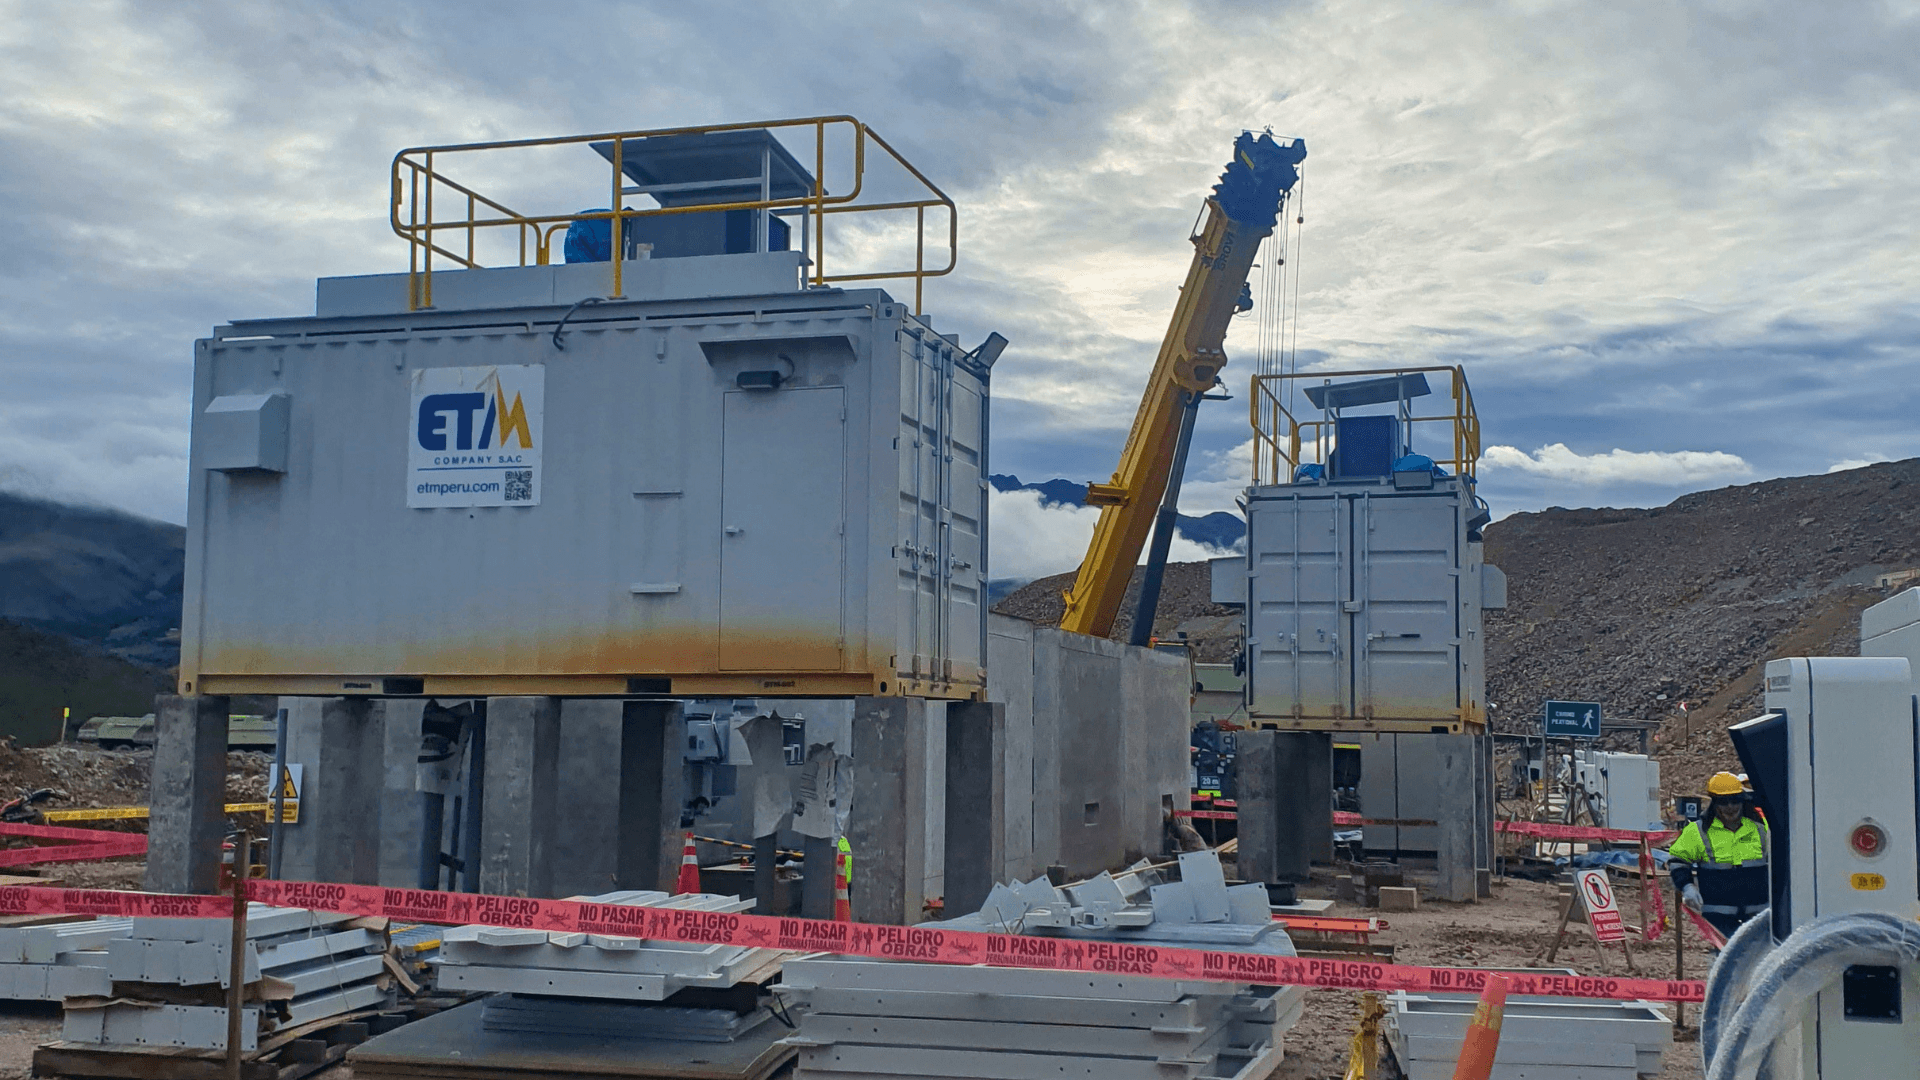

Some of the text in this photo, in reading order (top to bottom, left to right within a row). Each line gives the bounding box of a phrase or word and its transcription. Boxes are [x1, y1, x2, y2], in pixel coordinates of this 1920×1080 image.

[418, 374, 533, 450] ETM
[434, 456, 492, 465] COMPANY
[417, 482, 500, 496] etmperu.com
[0, 887, 30, 901] IGRO
[64, 890, 121, 906] NO PASAR
[284, 883, 345, 900] PELIGRO
[384, 889, 448, 910] NO PASAR
[0, 899, 28, 911] RAS
[150, 904, 199, 917] OBRAS
[476, 896, 540, 916] PELIGRO
[479, 912, 534, 927] OBRAS
[578, 904, 645, 926] NO PASAR
[673, 911, 739, 931] PELIGRO
[677, 927, 733, 942] OBRAS
[779, 920, 848, 941] NO PASAR
[877, 926, 944, 946] PELIGRO
[881, 942, 939, 958] OBRAS
[987, 936, 1057, 957] NO PASAR
[1088, 943, 1158, 964] PELIGRO
[1092, 959, 1153, 974] OBRAS
[1203, 953, 1277, 974] NO PASAR
[1309, 960, 1383, 980] PELIGRO
[1315, 976, 1379, 988] OBRAS
[1430, 970, 1486, 988] NO PAS
[1541, 977, 1618, 993] PELIGRO
[1667, 983, 1689, 997] NO
